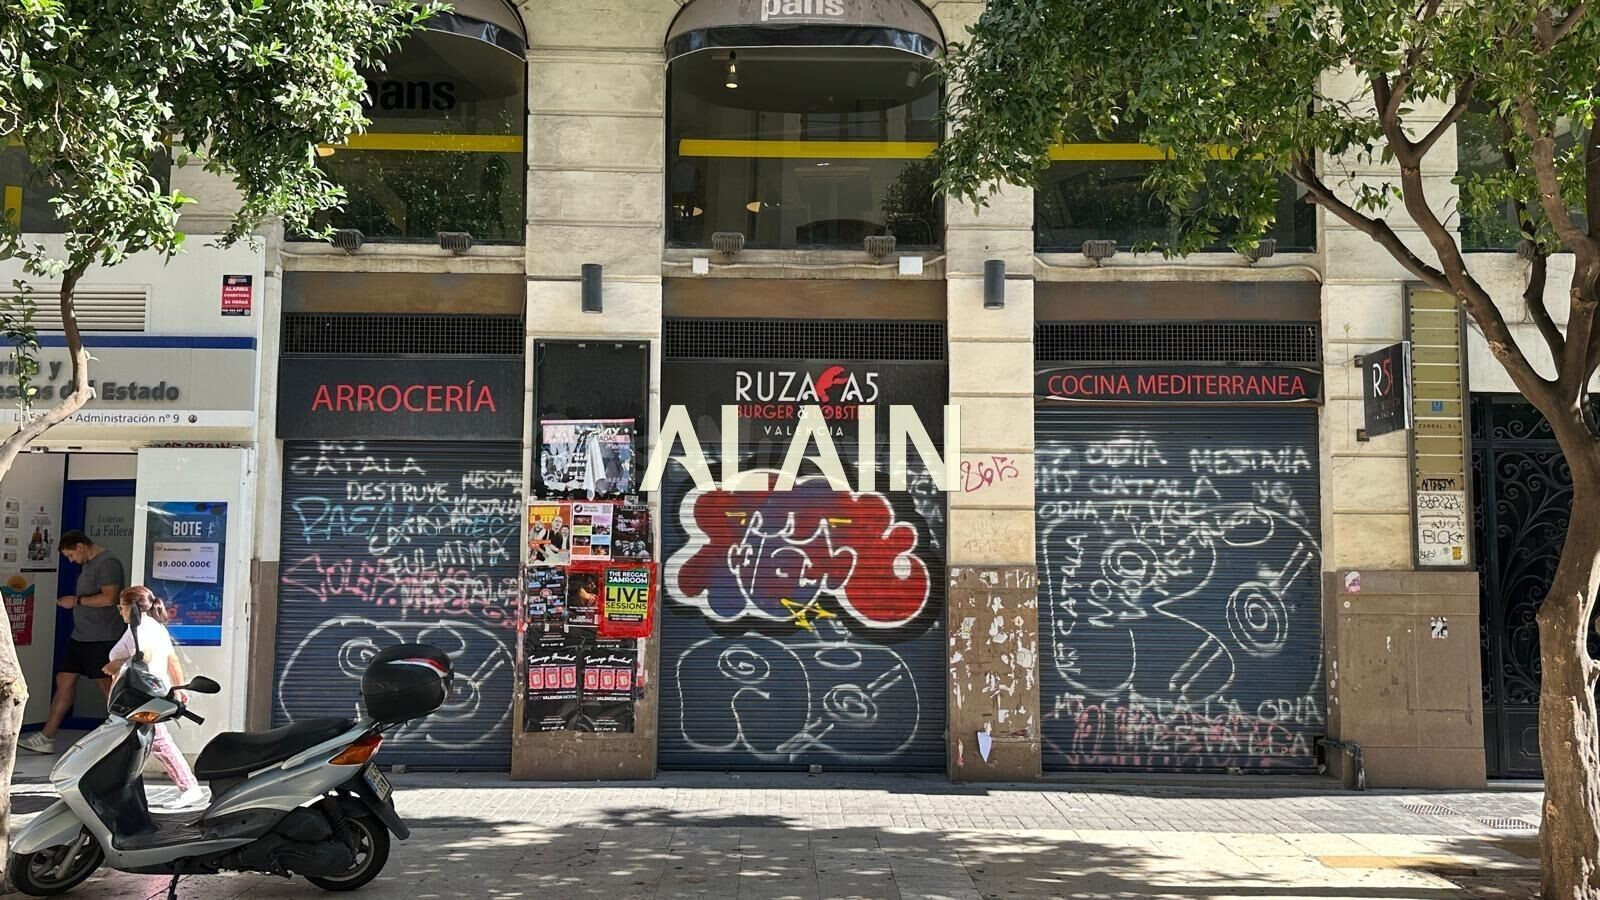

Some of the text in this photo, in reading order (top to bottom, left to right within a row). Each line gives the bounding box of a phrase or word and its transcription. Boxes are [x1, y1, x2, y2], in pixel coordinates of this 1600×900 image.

[102, 381, 180, 401] Estado
[1048, 374, 1305, 396] COCINA MEDITERRANEA
[311, 380, 496, 412] ARROCERÍA
[75, 413, 156, 424] Administración
[173, 414, 180, 423] 9
[172, 521, 202, 536] BOTE
[157, 560, 212, 569] 49.000.000€
[605, 587, 648, 602] LIVE
[605, 601, 647, 610] SESSIONS
